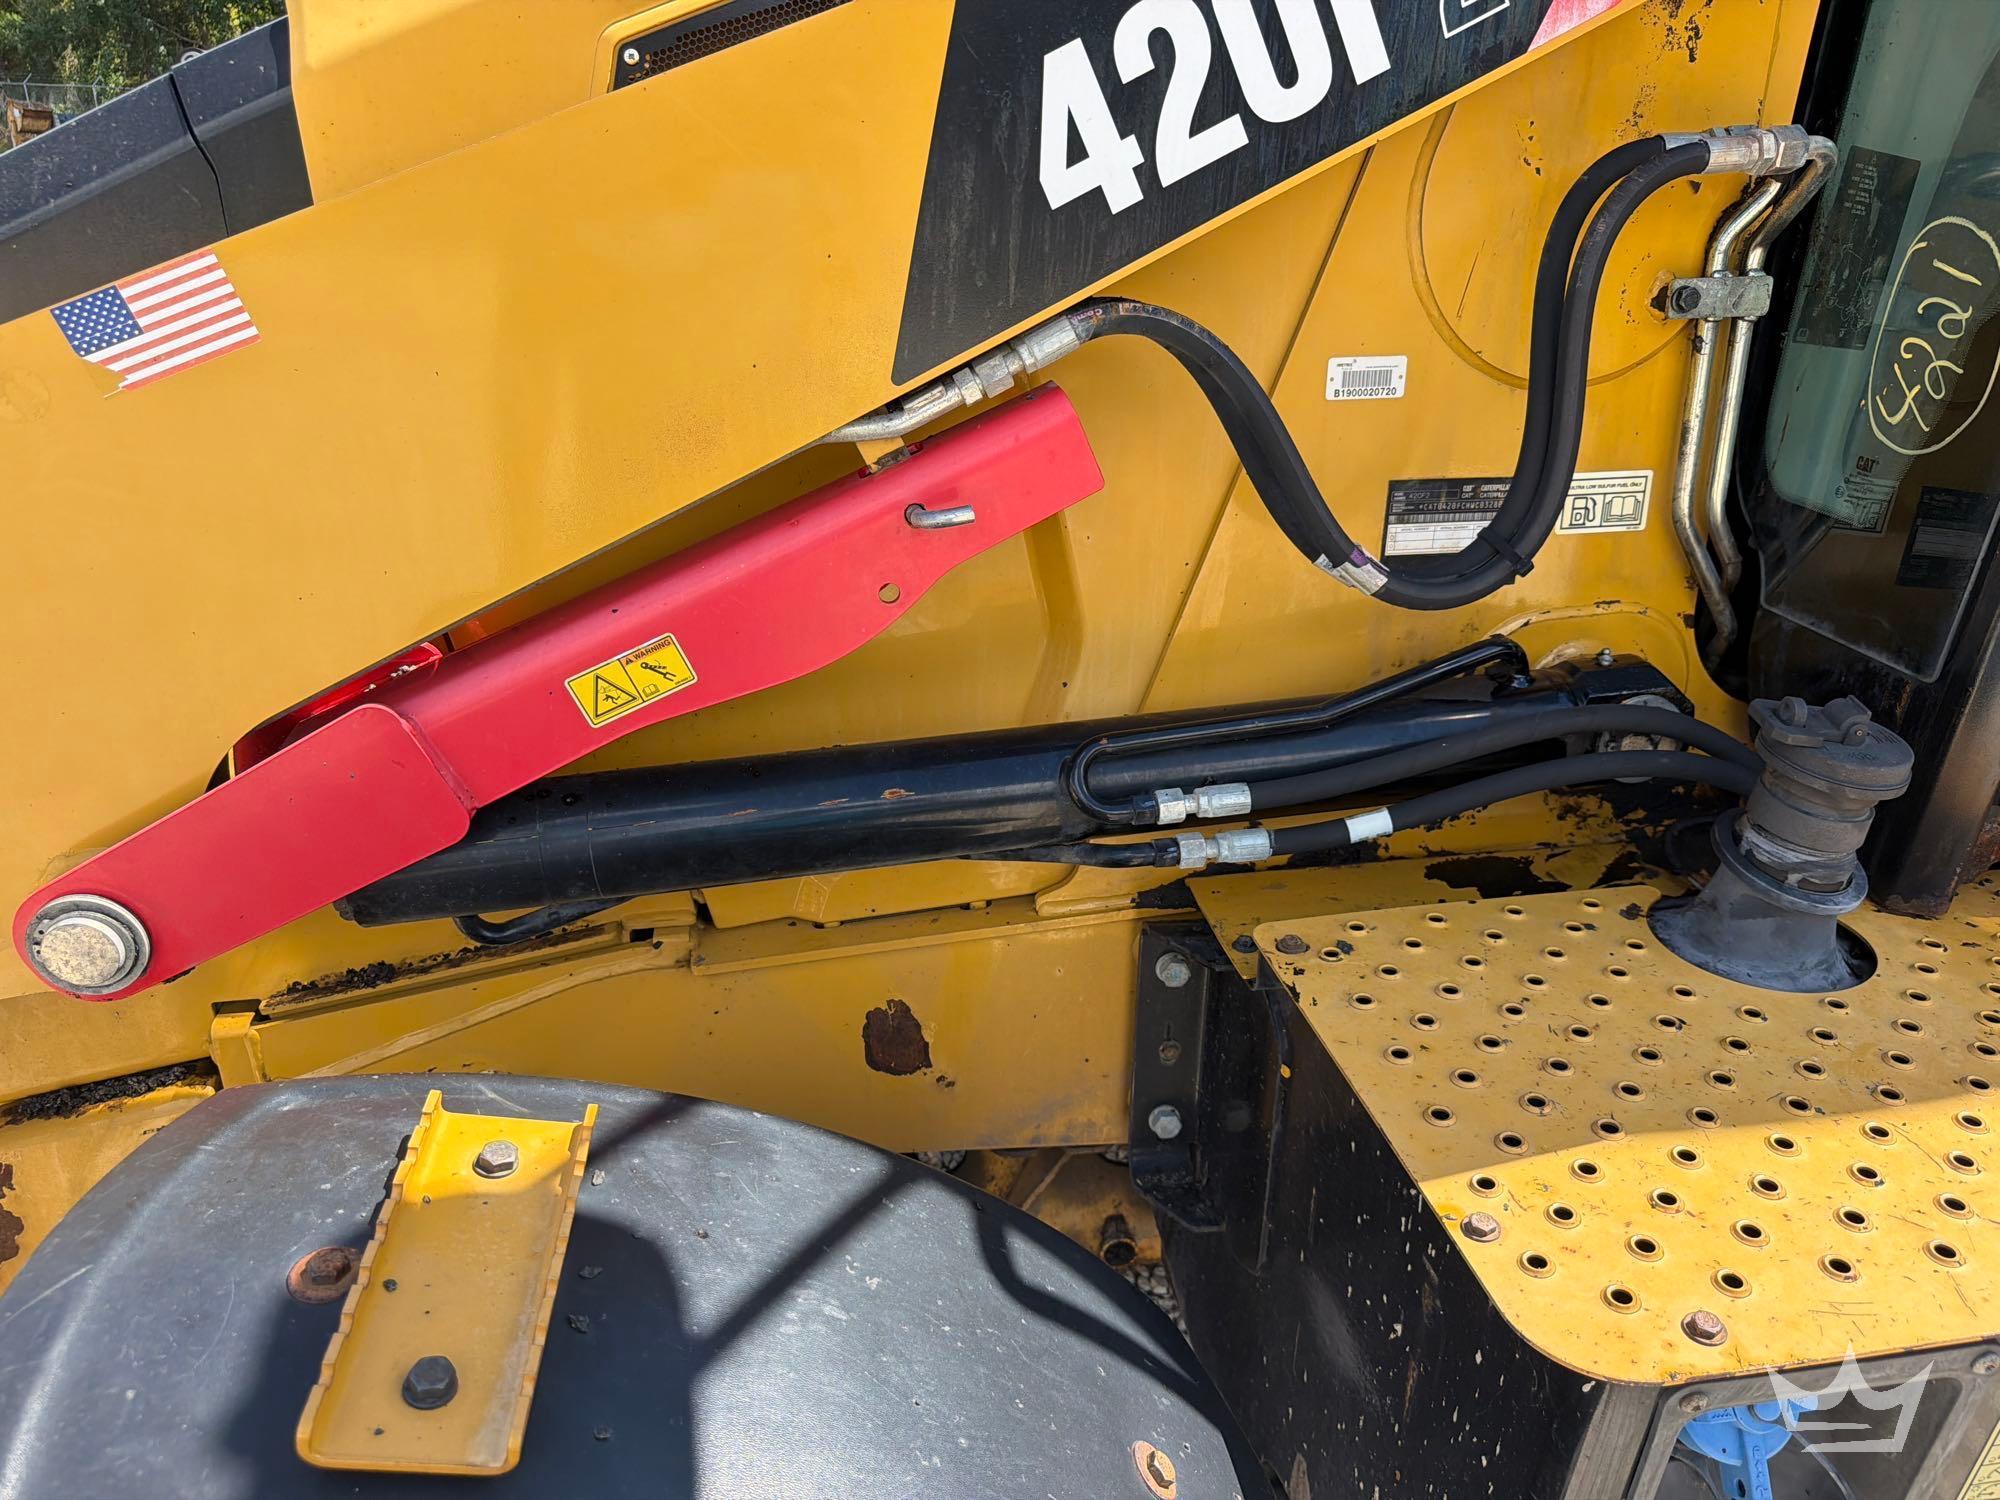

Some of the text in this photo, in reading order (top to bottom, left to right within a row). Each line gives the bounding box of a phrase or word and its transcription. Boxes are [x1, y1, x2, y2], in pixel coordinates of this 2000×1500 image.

[1333, 387, 1397, 398] B1900020720
[1856, 455, 1877, 474] CAT
[633, 639, 672, 661] WARNING
